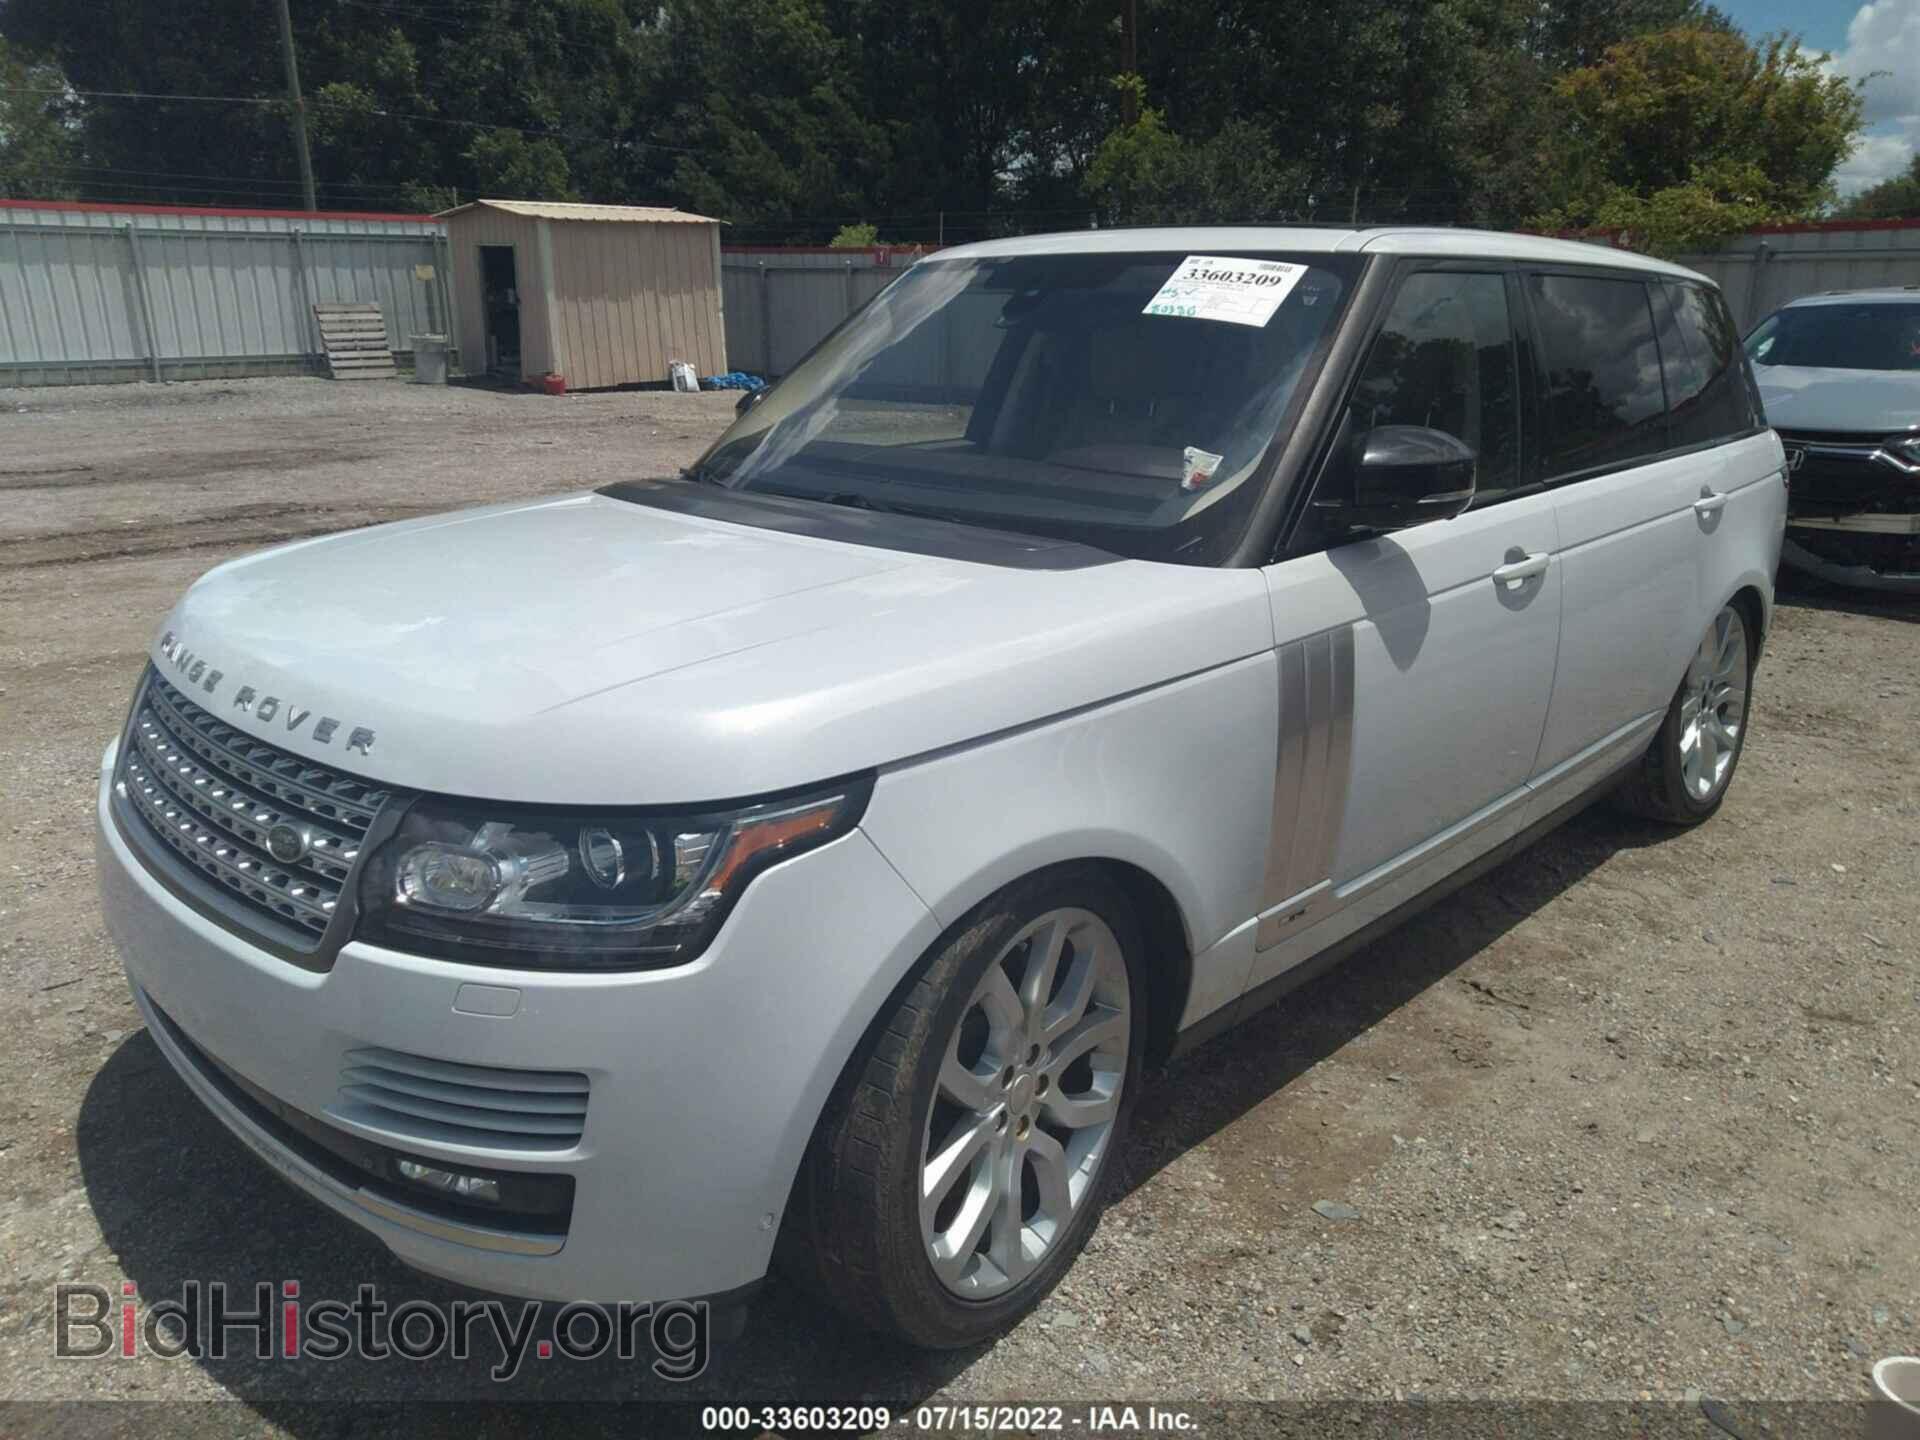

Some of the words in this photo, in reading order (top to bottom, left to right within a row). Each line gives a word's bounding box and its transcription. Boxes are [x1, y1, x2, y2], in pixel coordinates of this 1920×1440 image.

[1183, 268, 1282, 287] 33603209
[161, 630, 224, 693] RANGE
[233, 685, 376, 756] ROVER
